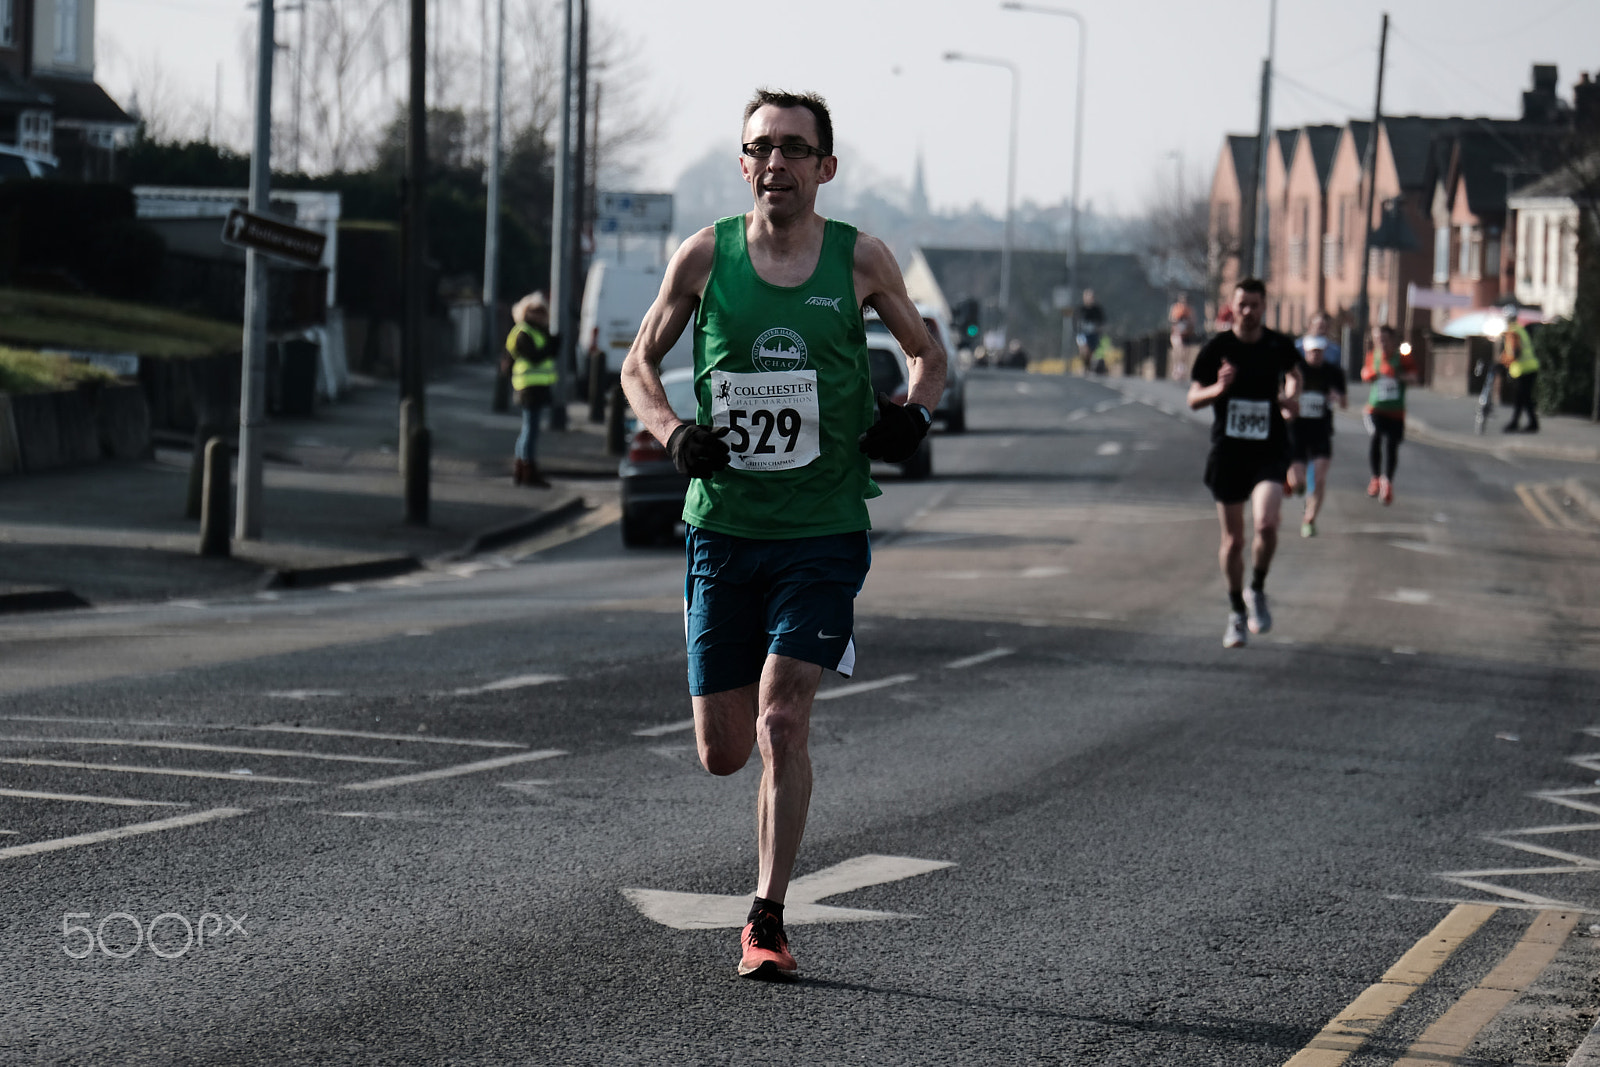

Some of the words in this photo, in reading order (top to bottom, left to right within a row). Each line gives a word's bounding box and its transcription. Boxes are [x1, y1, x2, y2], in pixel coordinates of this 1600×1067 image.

[753, 329, 779, 360] COLCHESTER
[780, 329, 805, 351] HARRIERS
[764, 359, 794, 368] CHAC
[734, 383, 813, 396] COLCHESTER
[761, 396, 812, 405] MARATHON
[1230, 414, 1266, 434] 1890
[729, 408, 802, 454] 529
[767, 459, 796, 467] CHAPMAN
